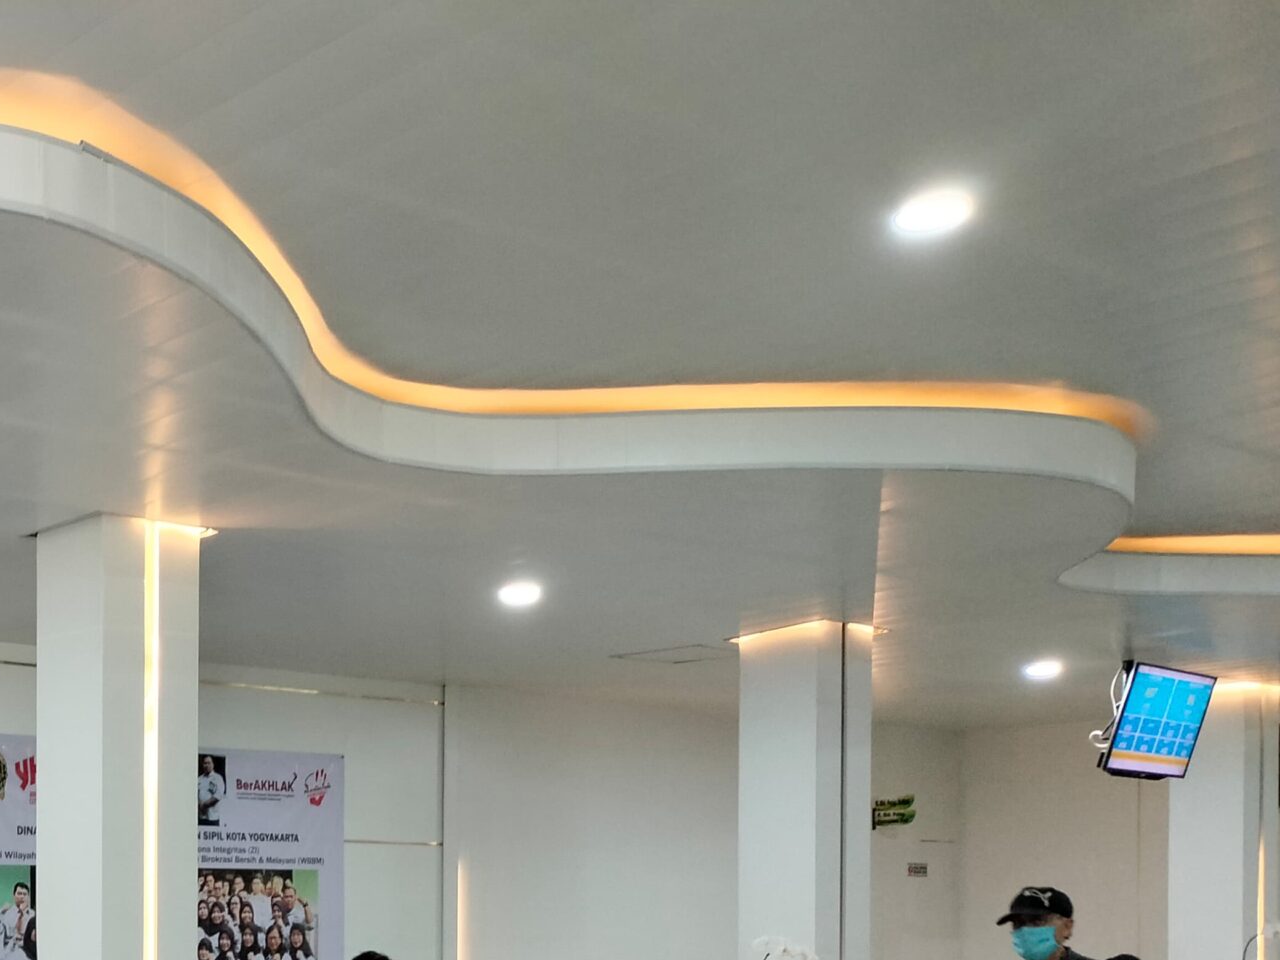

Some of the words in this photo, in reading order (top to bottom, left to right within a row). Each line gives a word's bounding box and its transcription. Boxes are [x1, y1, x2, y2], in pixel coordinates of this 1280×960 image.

[236, 773, 297, 793] BerAKHLAK
[203, 831, 224, 841] SIPIL
[226, 832, 246, 841] KOTA
[248, 833, 299, 843] YOGYAKARTA
[213, 846, 246, 855] Integritas
[4, 851, 36, 862] Wilayah
